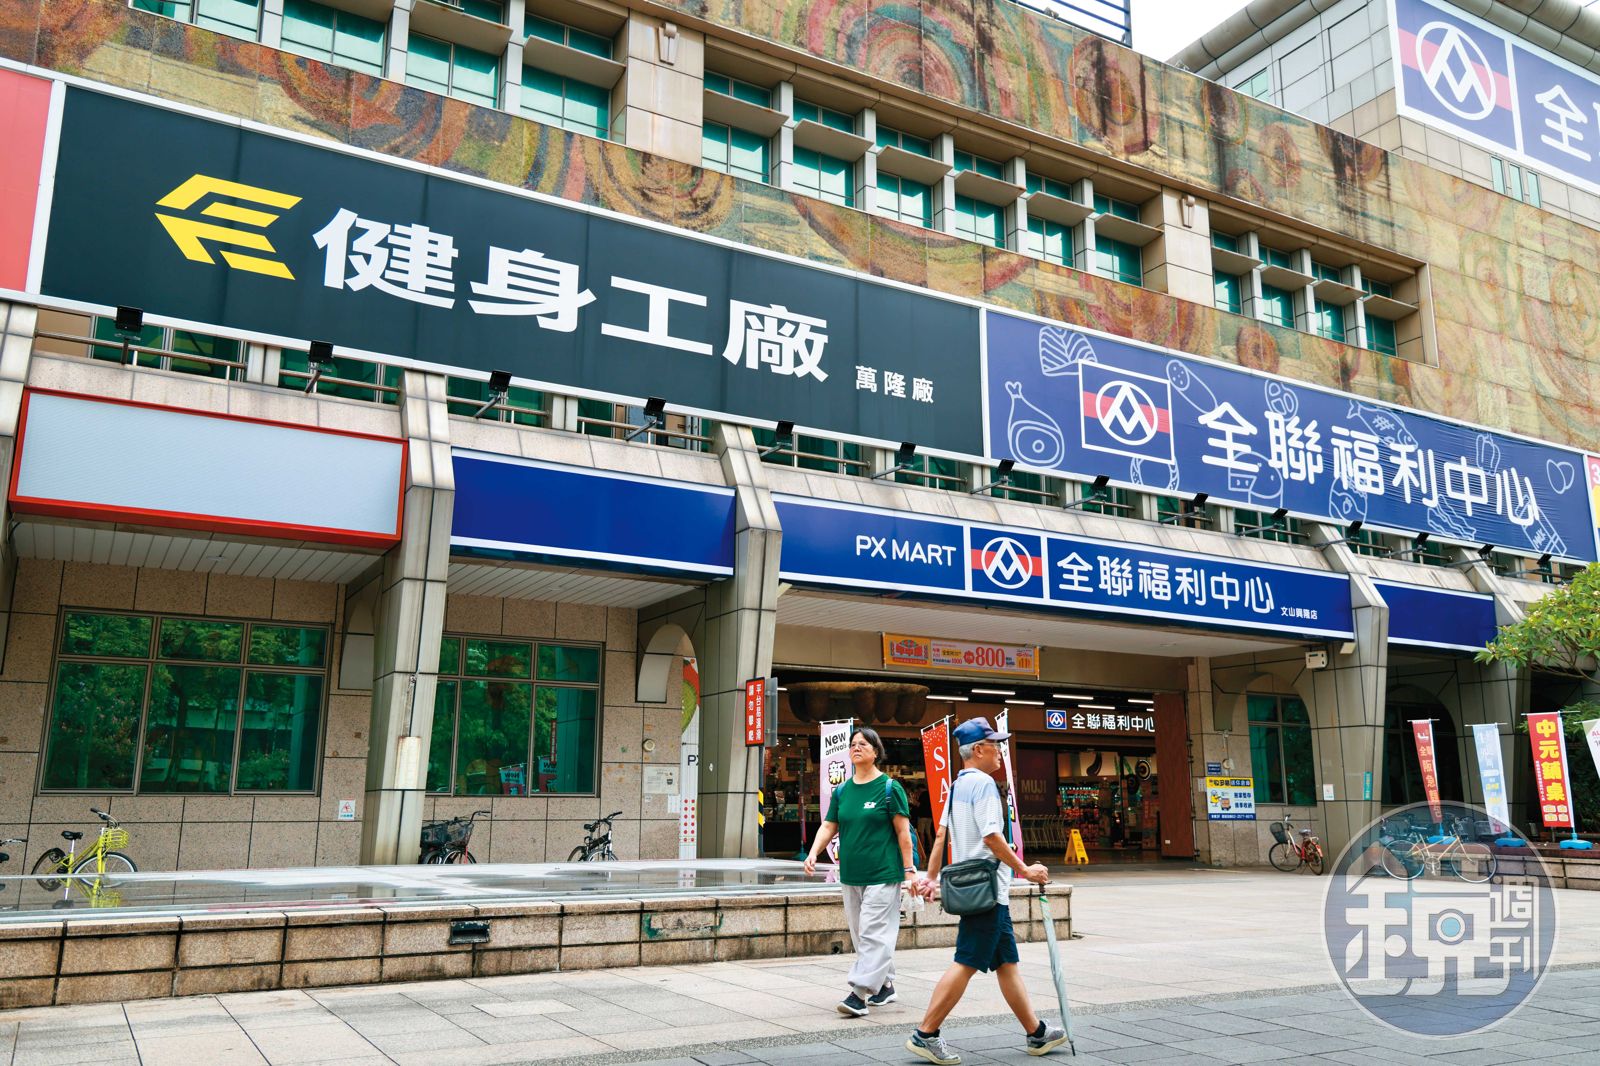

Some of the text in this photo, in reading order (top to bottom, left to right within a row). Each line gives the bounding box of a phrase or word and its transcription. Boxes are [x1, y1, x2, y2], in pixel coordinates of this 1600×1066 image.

[1535, 84, 1600, 162] 全
[312, 207, 829, 382] 健身工廠
[855, 365, 934, 404] 萬隆廠
[1198, 401, 1540, 526] 全聯福利中心
[856, 534, 957, 567] PX MART
[1057, 551, 1275, 614] 全聯福利中心
[1280, 606, 1318, 620] 文山興隆店
[975, 646, 1005, 668] 800
[1071, 712, 1155, 733] 全聯福利中心
[824, 731, 847, 748] New
[687, 754, 699, 766] P
[1021, 779, 1047, 794] MUJI
